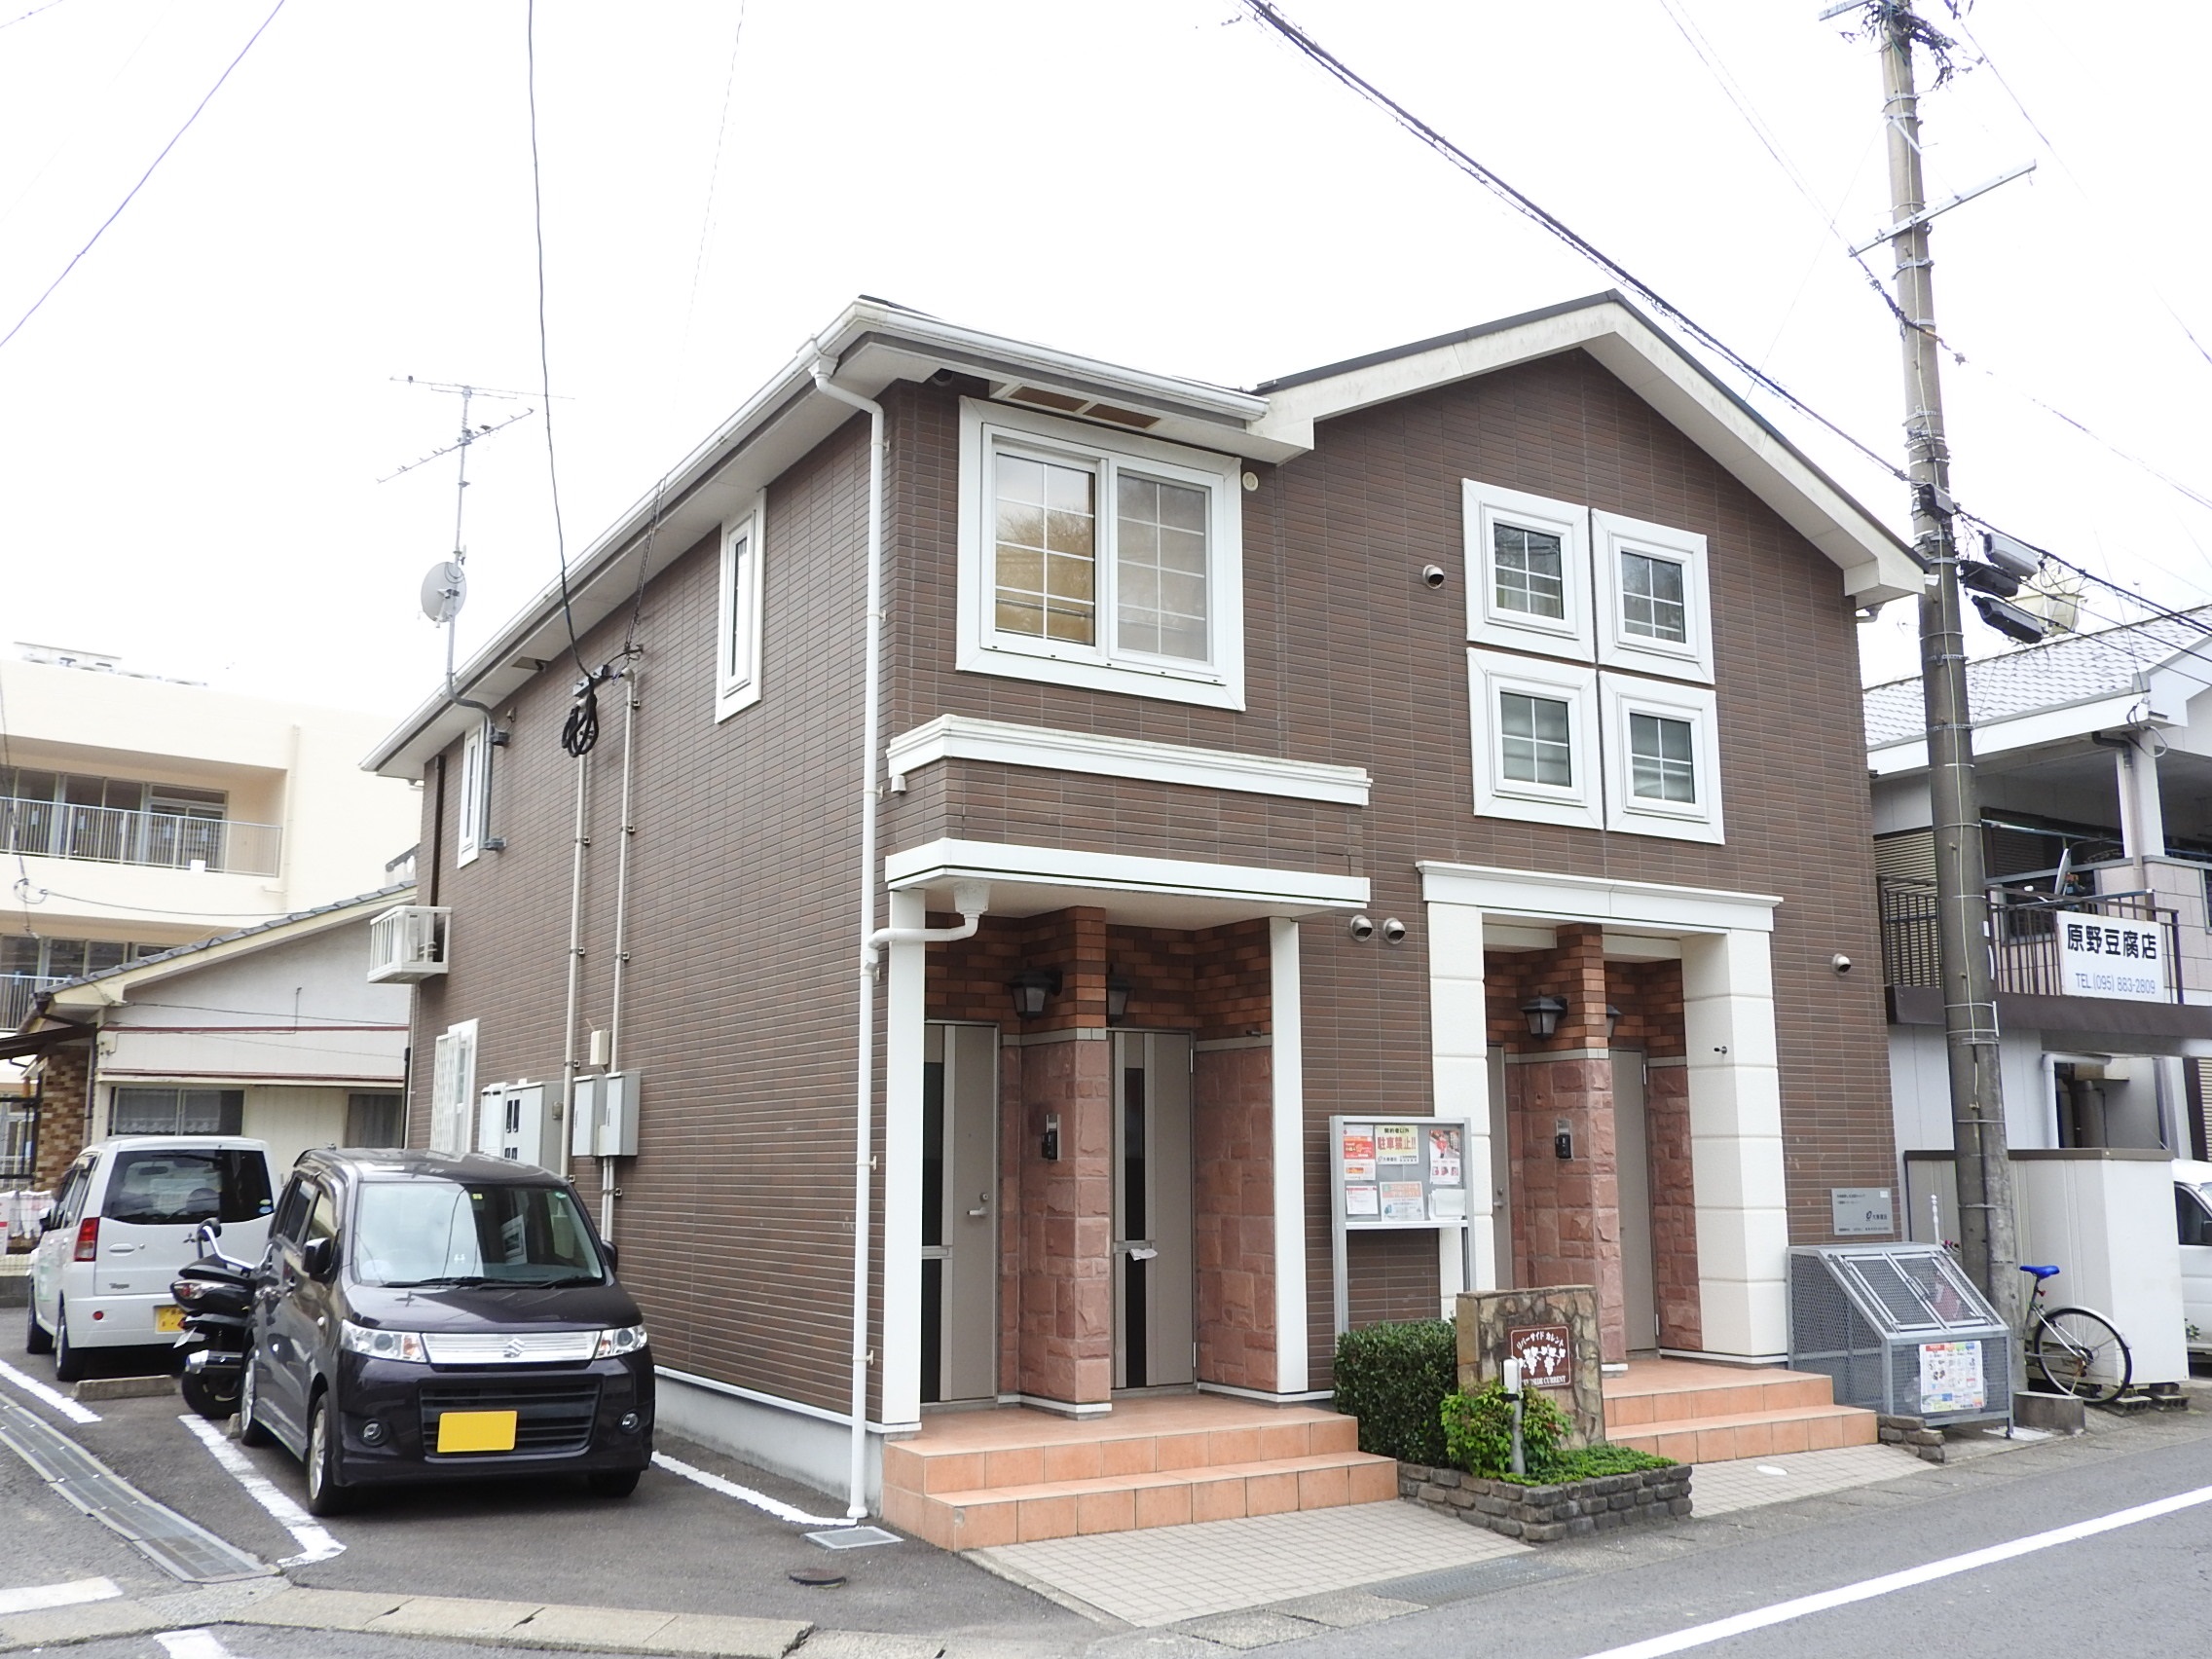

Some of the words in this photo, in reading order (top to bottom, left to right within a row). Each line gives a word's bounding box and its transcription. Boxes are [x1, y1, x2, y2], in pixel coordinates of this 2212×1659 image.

[2067, 923, 2157, 960] 原野豆腐店
